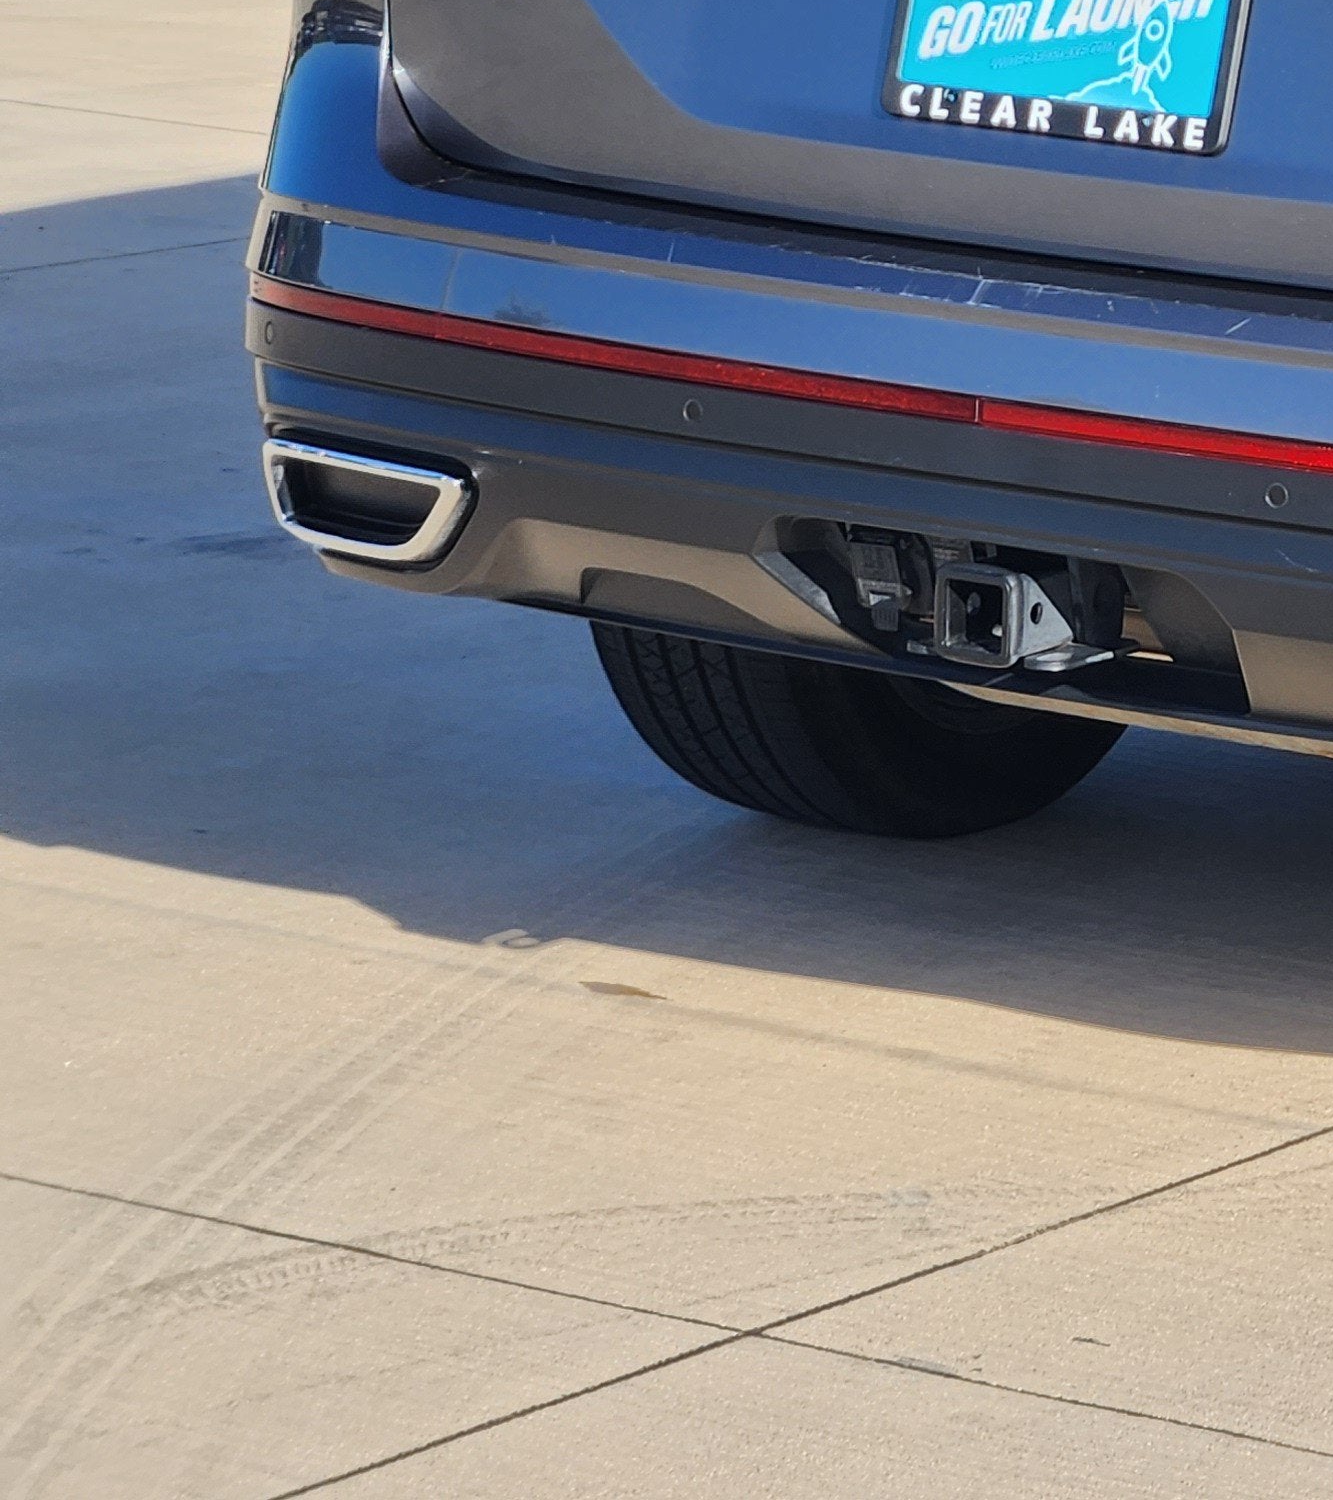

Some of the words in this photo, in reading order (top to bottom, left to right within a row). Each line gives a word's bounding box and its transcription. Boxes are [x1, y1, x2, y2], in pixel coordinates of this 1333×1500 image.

[917, 0, 986, 60] GO
[979, 0, 1033, 45] FOR
[900, 84, 1053, 133] CLEAR
[1084, 106, 1208, 152] LAKE
